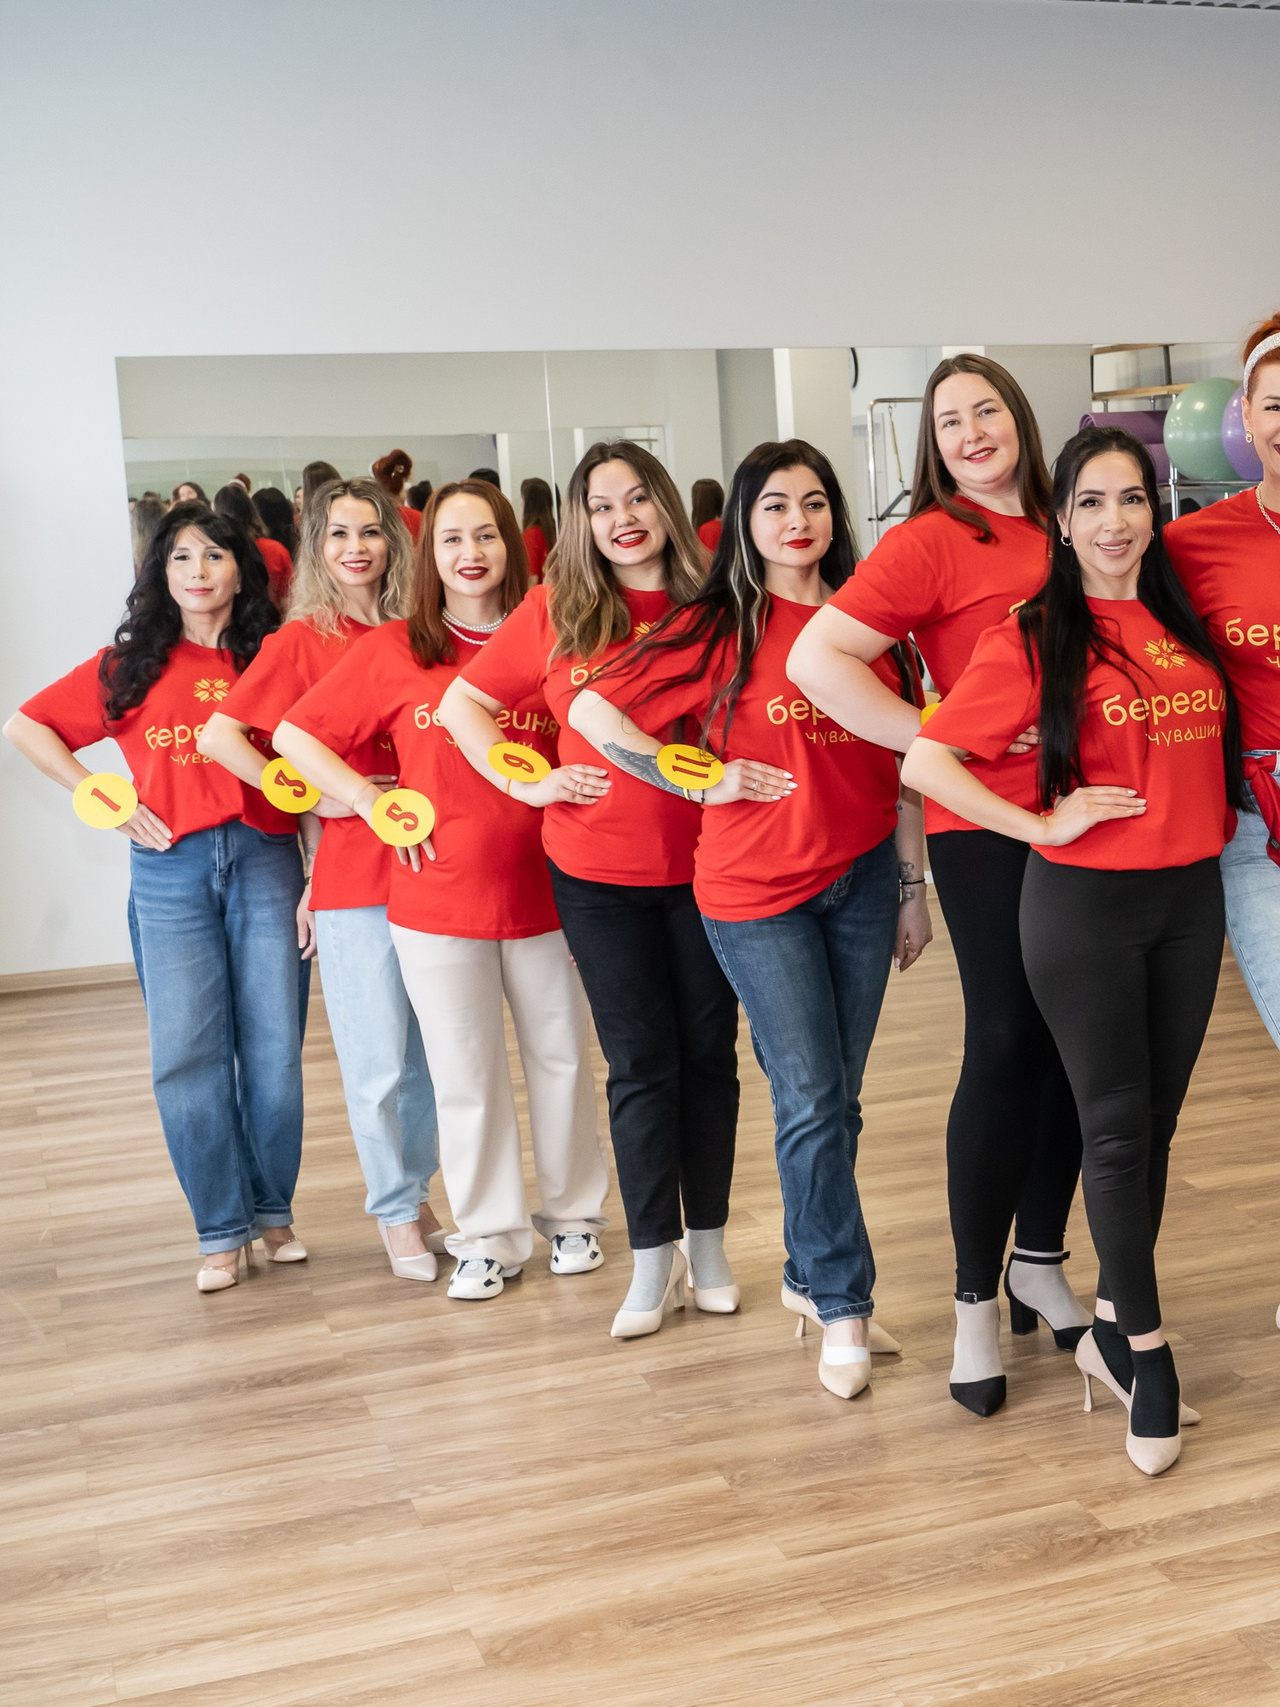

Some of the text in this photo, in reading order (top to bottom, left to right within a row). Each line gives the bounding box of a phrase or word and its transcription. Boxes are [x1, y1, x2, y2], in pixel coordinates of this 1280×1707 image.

[1102, 688, 1226, 726] береги
[274, 770, 307, 798] 3
[91, 788, 121, 812] 1
[386, 802, 419, 831] 5
